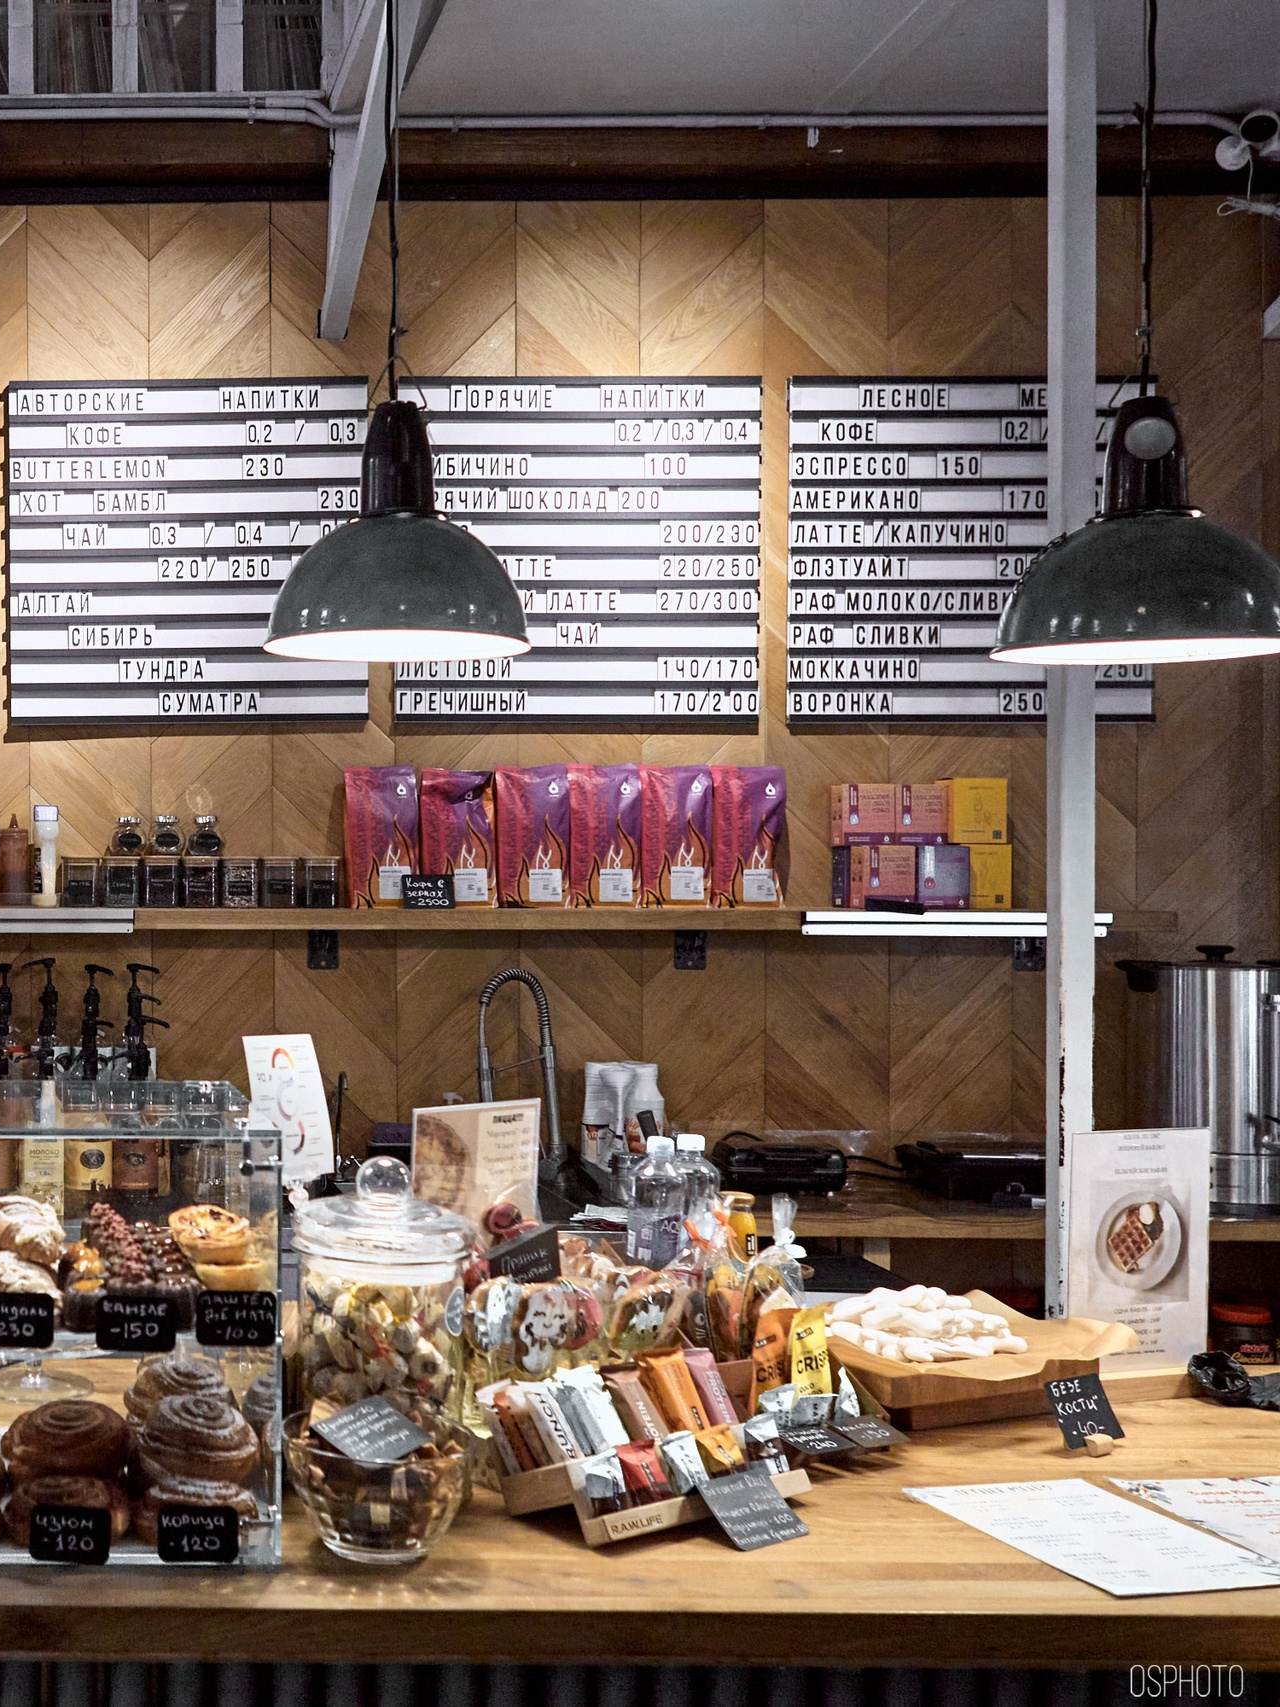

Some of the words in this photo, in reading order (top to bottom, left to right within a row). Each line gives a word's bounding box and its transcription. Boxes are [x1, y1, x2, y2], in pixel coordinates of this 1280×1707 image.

[20, 393, 144, 413] АВТОРСКИЕ
[223, 389, 319, 410] НАПИТКИ
[454, 389, 552, 409] ГОРЯЧИЕ
[604, 389, 705, 409] НАПИТКИ
[861, 388, 947, 408] ЛЕСНОЕ
[1021, 388, 1047, 407] МЕ
[70, 425, 121, 445] КОФЕ
[821, 422, 874, 441] КОФЕ
[13, 459, 166, 480] BUTTERLEMON
[246, 458, 284, 477] 230
[432, 454, 528, 475] ЙБИЧИНО
[650, 458, 686, 475] 100
[795, 457, 906, 476] ЭСПРЕССО
[941, 456, 978, 475] 150
[22, 493, 61, 513] ХОТ
[97, 491, 166, 512] БАМБЛ
[321, 490, 359, 509] 230
[509, 491, 607, 512] ШОКОЛАД
[622, 490, 660, 509] 200
[793, 490, 919, 510] АМЕРИКАНО
[66, 523, 106, 546] ЧАЙ
[663, 525, 754, 544] 200/230
[232, 559, 270, 578] 250
[663, 558, 754, 577] 220/250
[794, 556, 906, 577] ФЛЭТУАЙТ
[1000, 558, 1024, 577] 20
[21, 592, 90, 613] АЛТАЙ
[549, 591, 616, 611] ЛАТТЕ
[660, 591, 752, 611] 270/300
[795, 592, 836, 612] РАФ
[847, 591, 1011, 611] МОЛОКО/СЛИВ
[71, 626, 152, 646] СИБИРЬ
[561, 622, 599, 644] ЧАЙ
[794, 626, 834, 646] РАФ
[856, 625, 939, 645] СЛИВКИ
[123, 660, 204, 681] ТУНДРА
[399, 661, 511, 678] ЛИСТОВОЙ
[662, 659, 753, 678] 140/170
[790, 659, 918, 679] МОККАЧИНО
[162, 693, 258, 713] СУМАТРА
[400, 690, 526, 711] ГРЕЧИШНЫЙ
[794, 690, 891, 711] ВОРОНКА
[1003, 692, 1042, 711] 250
[706, 1371, 732, 1423] PROTEIN
[1050, 1379, 1081, 1397] БЕЗЕ
